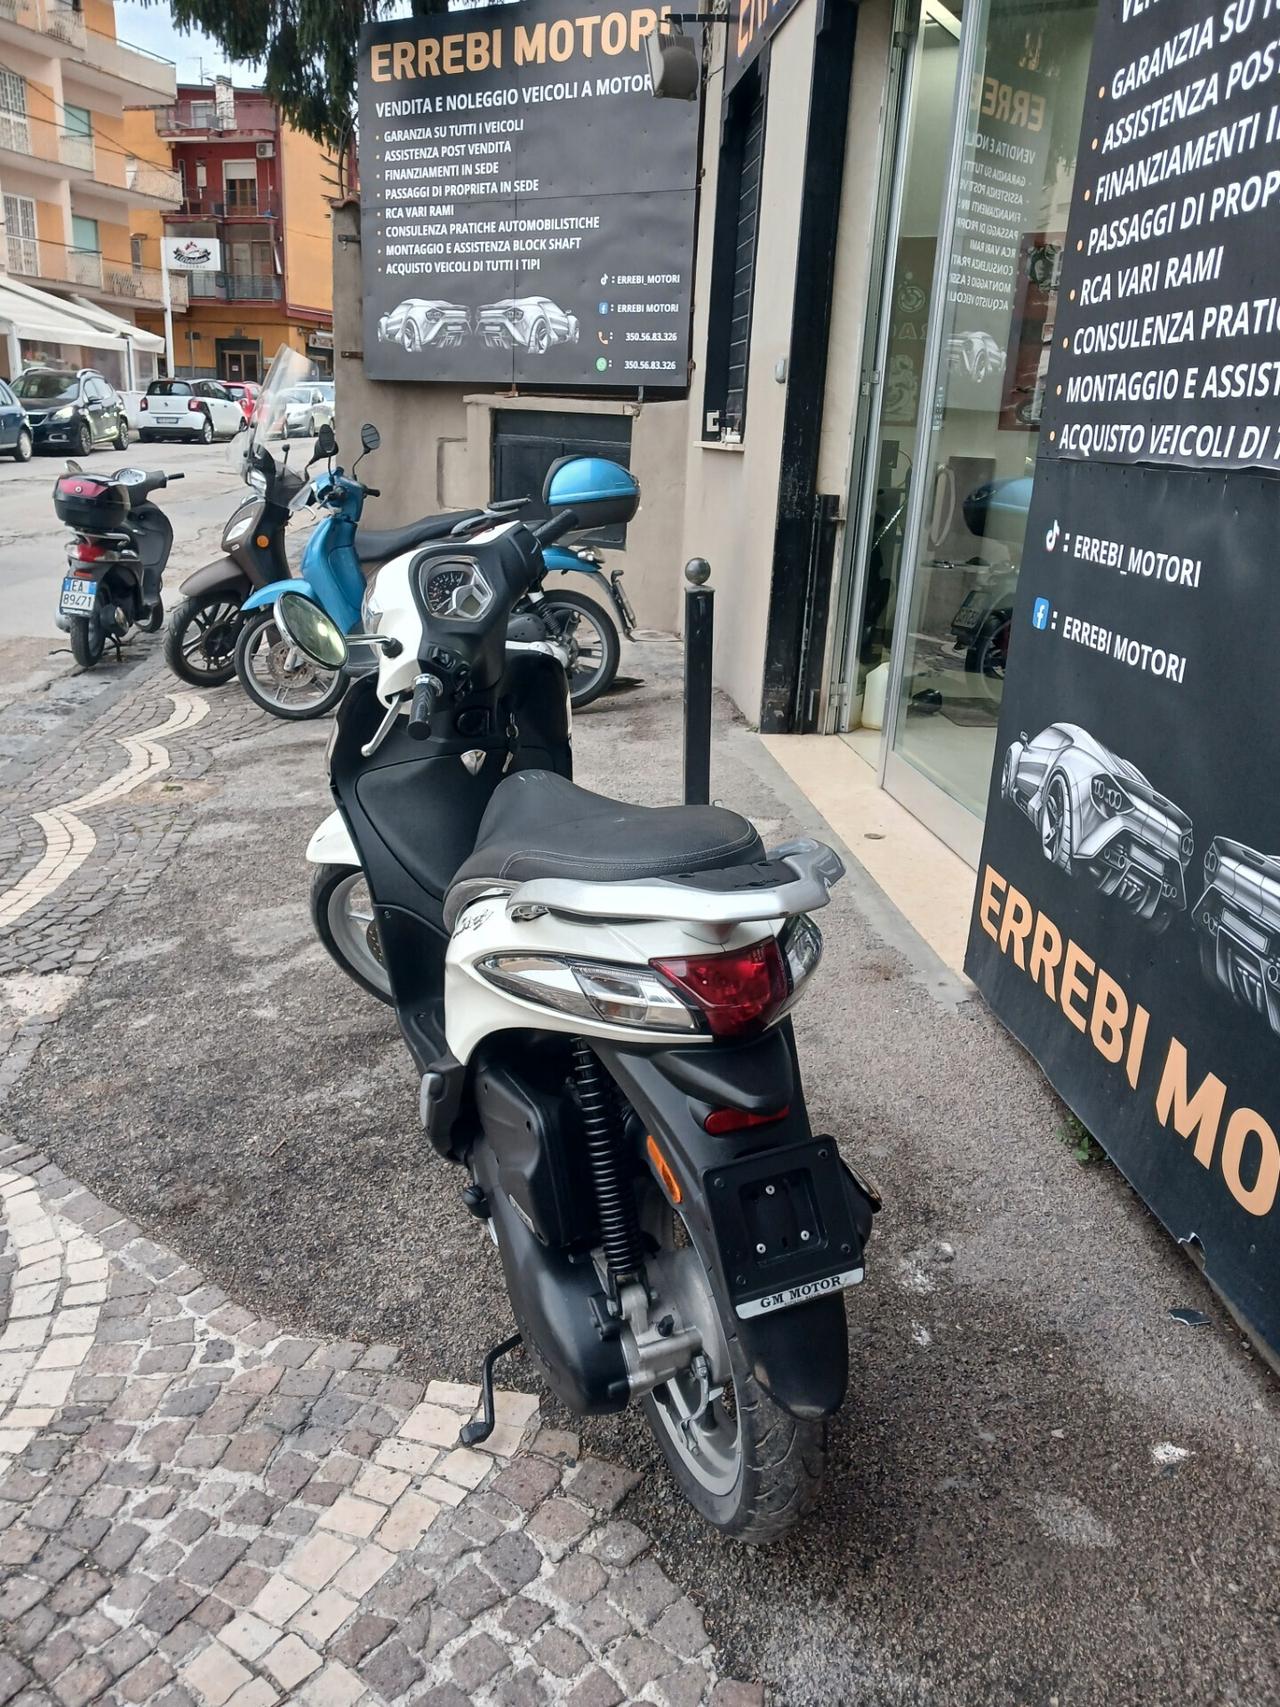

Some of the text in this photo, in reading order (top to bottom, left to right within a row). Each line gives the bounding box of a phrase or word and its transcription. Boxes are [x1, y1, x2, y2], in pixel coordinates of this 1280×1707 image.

[371, 28, 502, 83] ERREBI
[1111, 0, 1255, 100] GARANZIA SU
[375, 73, 654, 118] VENDITA E NOLEGGIO VEICOLI A MOTOR
[1102, 72, 1219, 154] ASSISTENZA
[384, 119, 524, 143] GARANZIA SU TUTTI I VEICOLI
[384, 141, 512, 162] ASSISTENZA POST VENDITA
[1095, 105, 1280, 205] FINANZIAMENTI I
[385, 161, 499, 181] FINANZIAMENTI IN SEDE
[385, 179, 539, 200] PASSAGGI DI PROPRIETA IN SEDE
[385, 204, 454, 219] RCA VARI RAMI
[386, 216, 600, 238] CONSULENZA PRATICHE AUTOMOBILISTICHE
[1088, 202, 1176, 256] PASSAGGI
[1180, 193, 1204, 230] DI
[386, 237, 581, 256] MONTAGGIO E ASSISTENZA BLOCK SHAFT
[386, 258, 540, 276] ACQUISTO VEICOLI DI TUTTI I TIPI
[617, 274, 680, 285] ERREBI_MOTORI
[1080, 246, 1224, 306] RCA VARI RAMI
[617, 303, 679, 313] ERREBI MOTORI
[1074, 298, 1280, 355] CONSULENZA PRATI
[1066, 369, 1179, 403] MONTAGGIO
[1183, 367, 1198, 399] E
[1059, 424, 1145, 456] ACQUISTO
[1150, 425, 1236, 458] VEICOLI
[1238, 425, 1271, 459] DI
[1074, 534, 1201, 588] ERREBI_MOTORI
[1063, 616, 1186, 684] ERREBI MOTORI
[979, 864, 1280, 1216] ERREBI MO
[760, 1293, 784, 1308] GM
[789, 1276, 841, 1300] MOTOR
